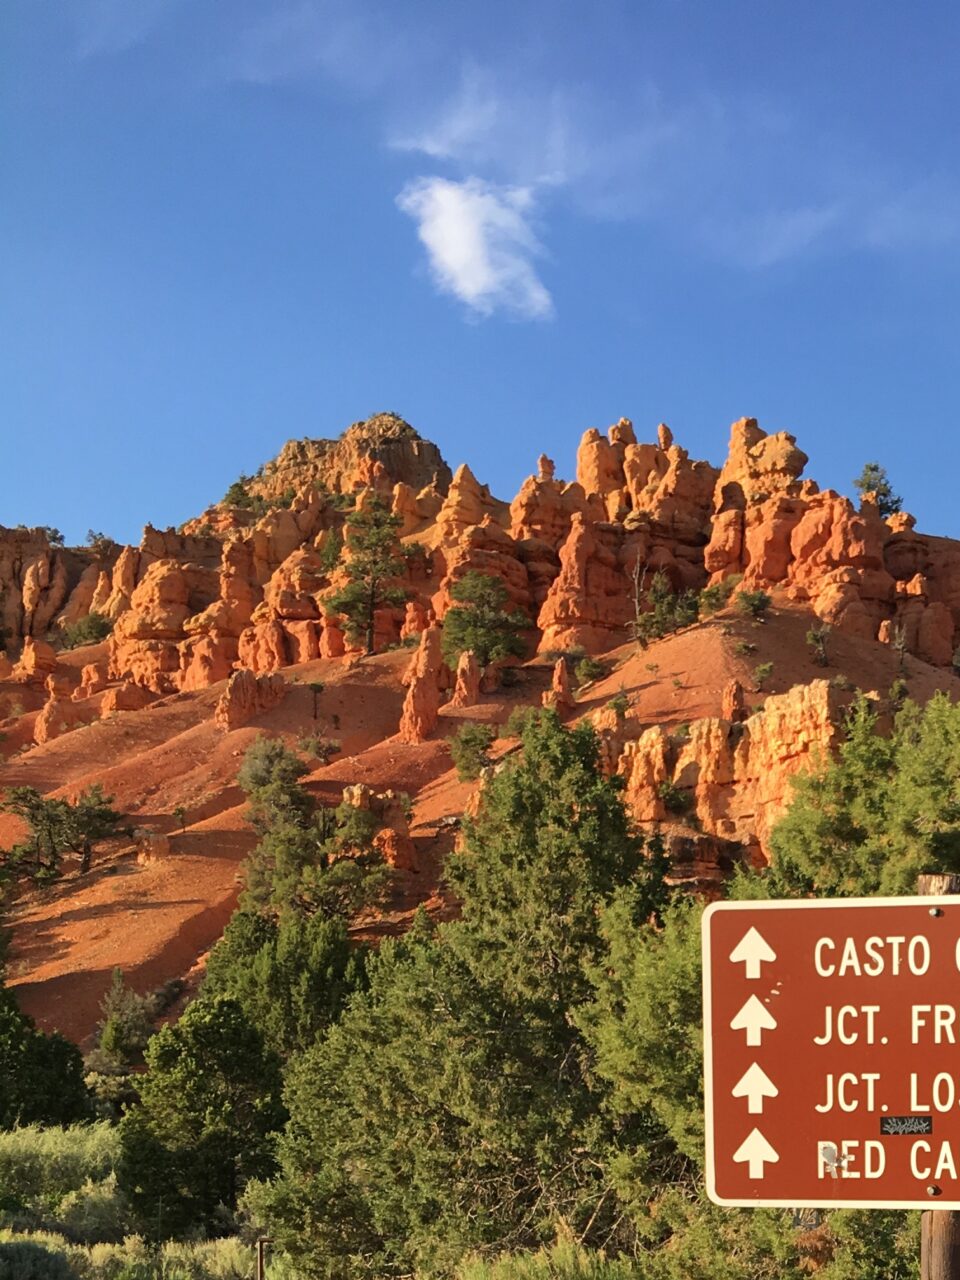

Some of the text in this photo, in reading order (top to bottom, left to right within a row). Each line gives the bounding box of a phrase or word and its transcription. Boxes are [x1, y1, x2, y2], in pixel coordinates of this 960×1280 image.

[814, 934, 931, 978] CASTO
[813, 1005, 889, 1046] JCT.
[814, 1072, 889, 1113] JCT.
[817, 1140, 886, 1180] RED
